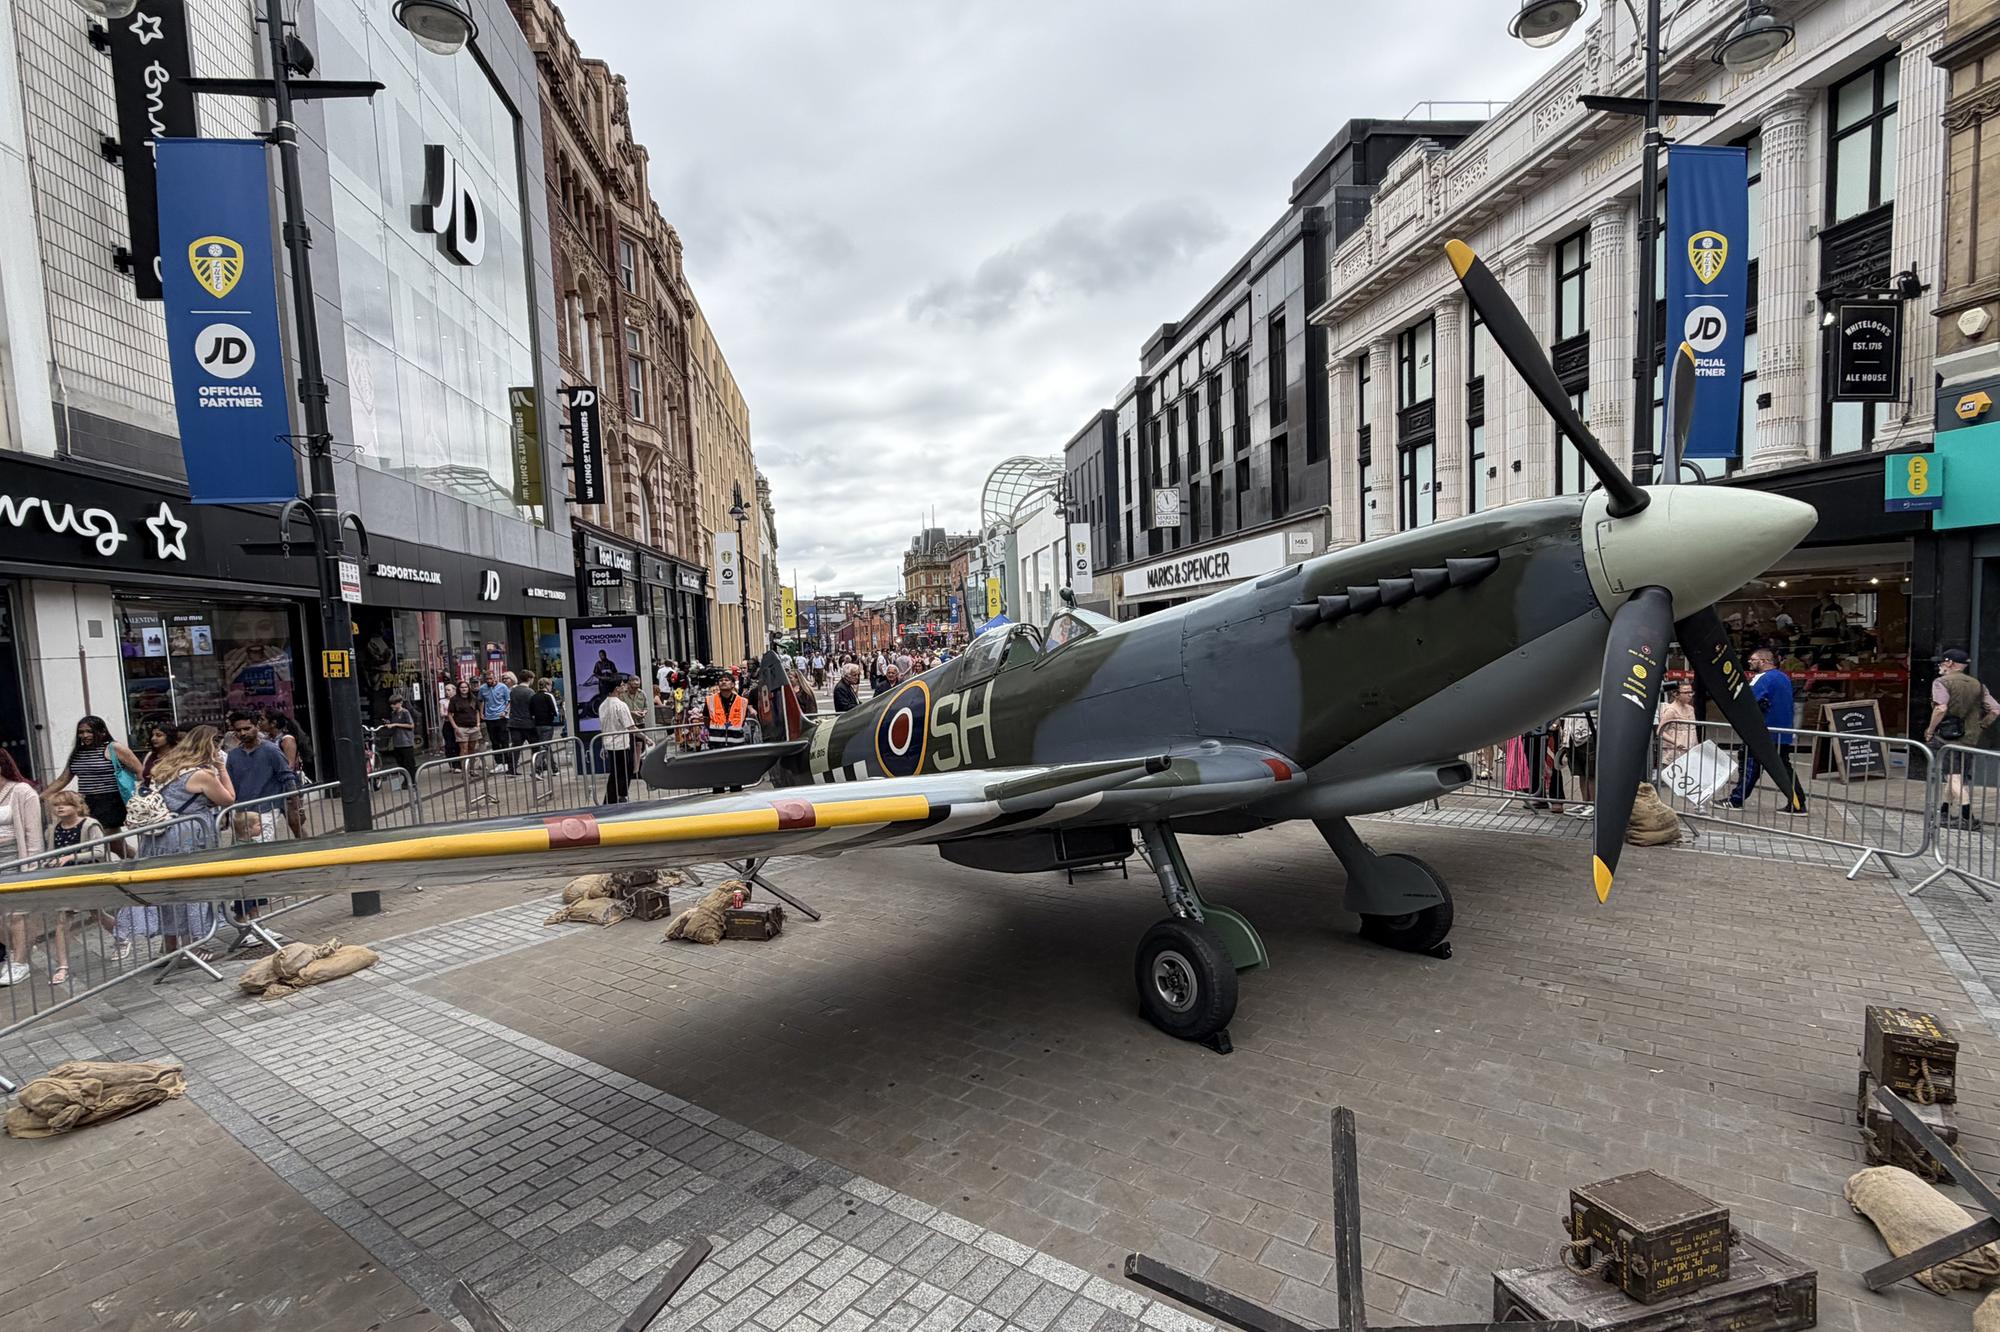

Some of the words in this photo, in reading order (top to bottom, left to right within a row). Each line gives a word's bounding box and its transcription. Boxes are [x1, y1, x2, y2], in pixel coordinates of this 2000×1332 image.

[430, 146, 486, 266] JD
[1689, 316, 1722, 341] JD
[204, 337, 248, 365] JD
[1852, 342, 1868, 351] EST.
[1868, 342, 1883, 351] 1715
[1695, 358, 1726, 367] FICIAL
[1695, 368, 1726, 377] RTNER
[1845, 373, 1861, 382] ALE
[1861, 373, 1887, 382] HOUSE
[198, 386, 262, 397] OFFICIAL
[571, 390, 596, 408] JD
[199, 397, 264, 408] PARTNER
[580, 410, 591, 454] TRAINERS
[584, 464, 593, 485] KING
[599, 546, 614, 569] Foot
[614, 549, 632, 572] Locker
[376, 563, 442, 584] JDSPORTS.CO.UK
[591, 570, 610, 579] Foot
[592, 577, 621, 586] Locker
[484, 569, 501, 601] JD
[580, 633, 627, 641] BOOHOOMAN
[931, 679, 996, 772] SH
